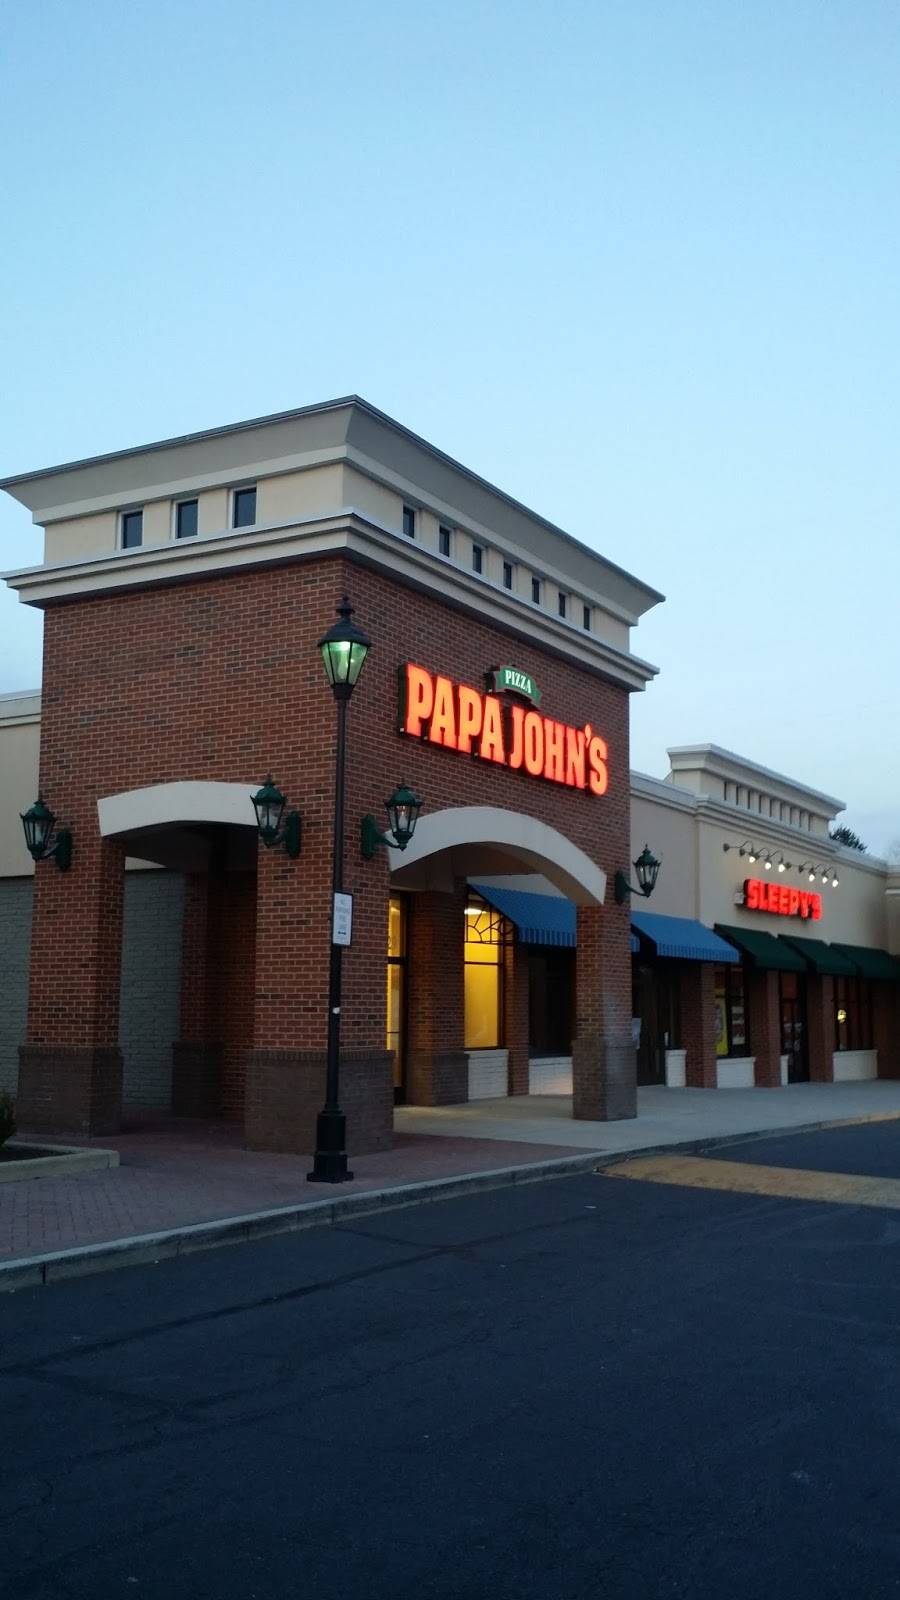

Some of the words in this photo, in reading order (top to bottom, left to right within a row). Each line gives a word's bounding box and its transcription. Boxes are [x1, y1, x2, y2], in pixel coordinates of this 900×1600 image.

[504, 669, 533, 694] PIZZA
[406, 663, 505, 765] PAPA
[510, 706, 608, 796] JOHN'S
[747, 878, 822, 921] SLEEPY'S
